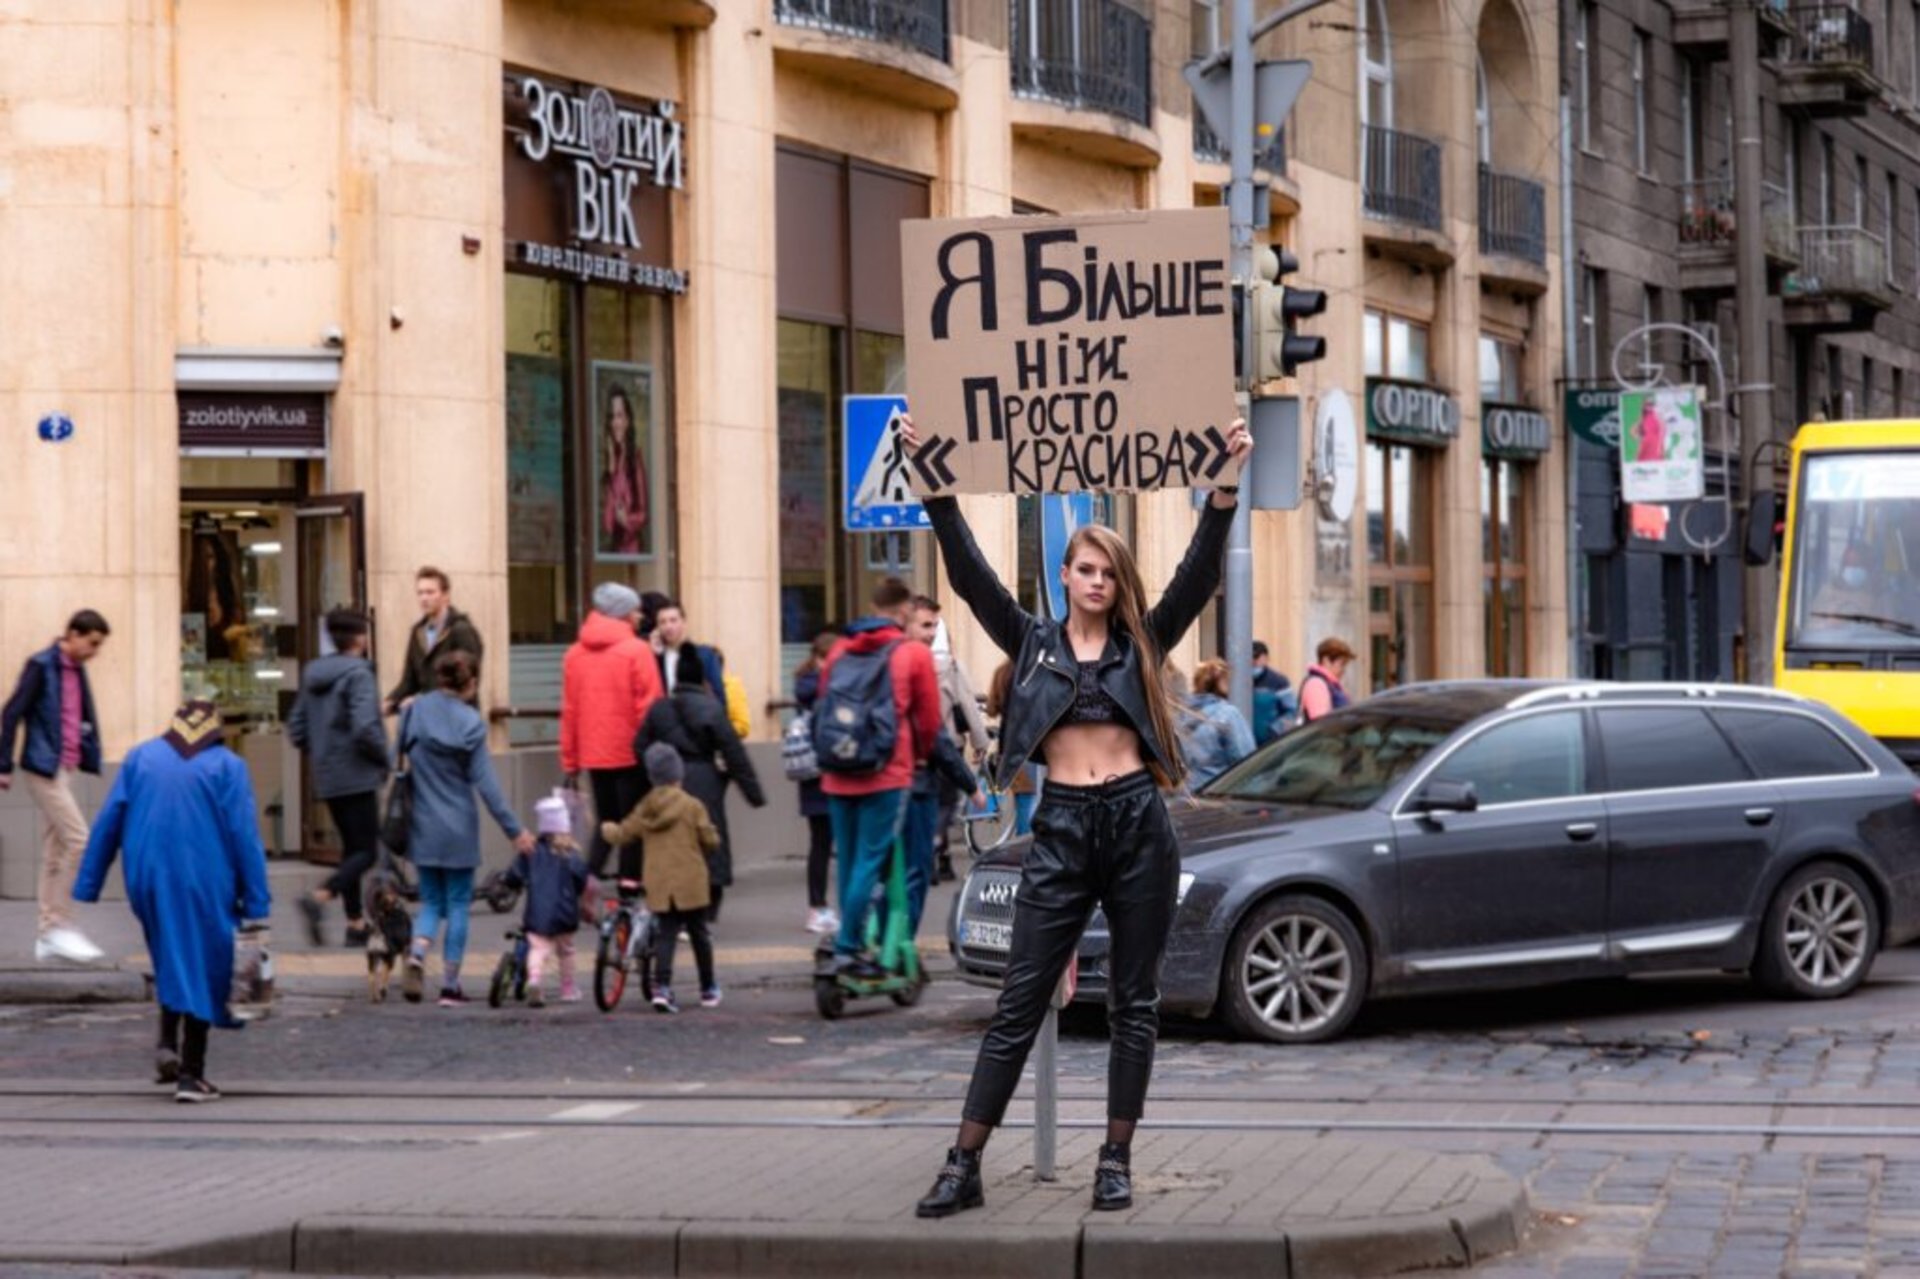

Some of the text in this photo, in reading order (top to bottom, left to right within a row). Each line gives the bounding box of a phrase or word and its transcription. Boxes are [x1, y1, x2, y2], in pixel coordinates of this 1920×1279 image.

[526, 240, 629, 283] ювелірний
[930, 230, 998, 340] Я
[187, 404, 307, 431] zolotiyvik.ua
